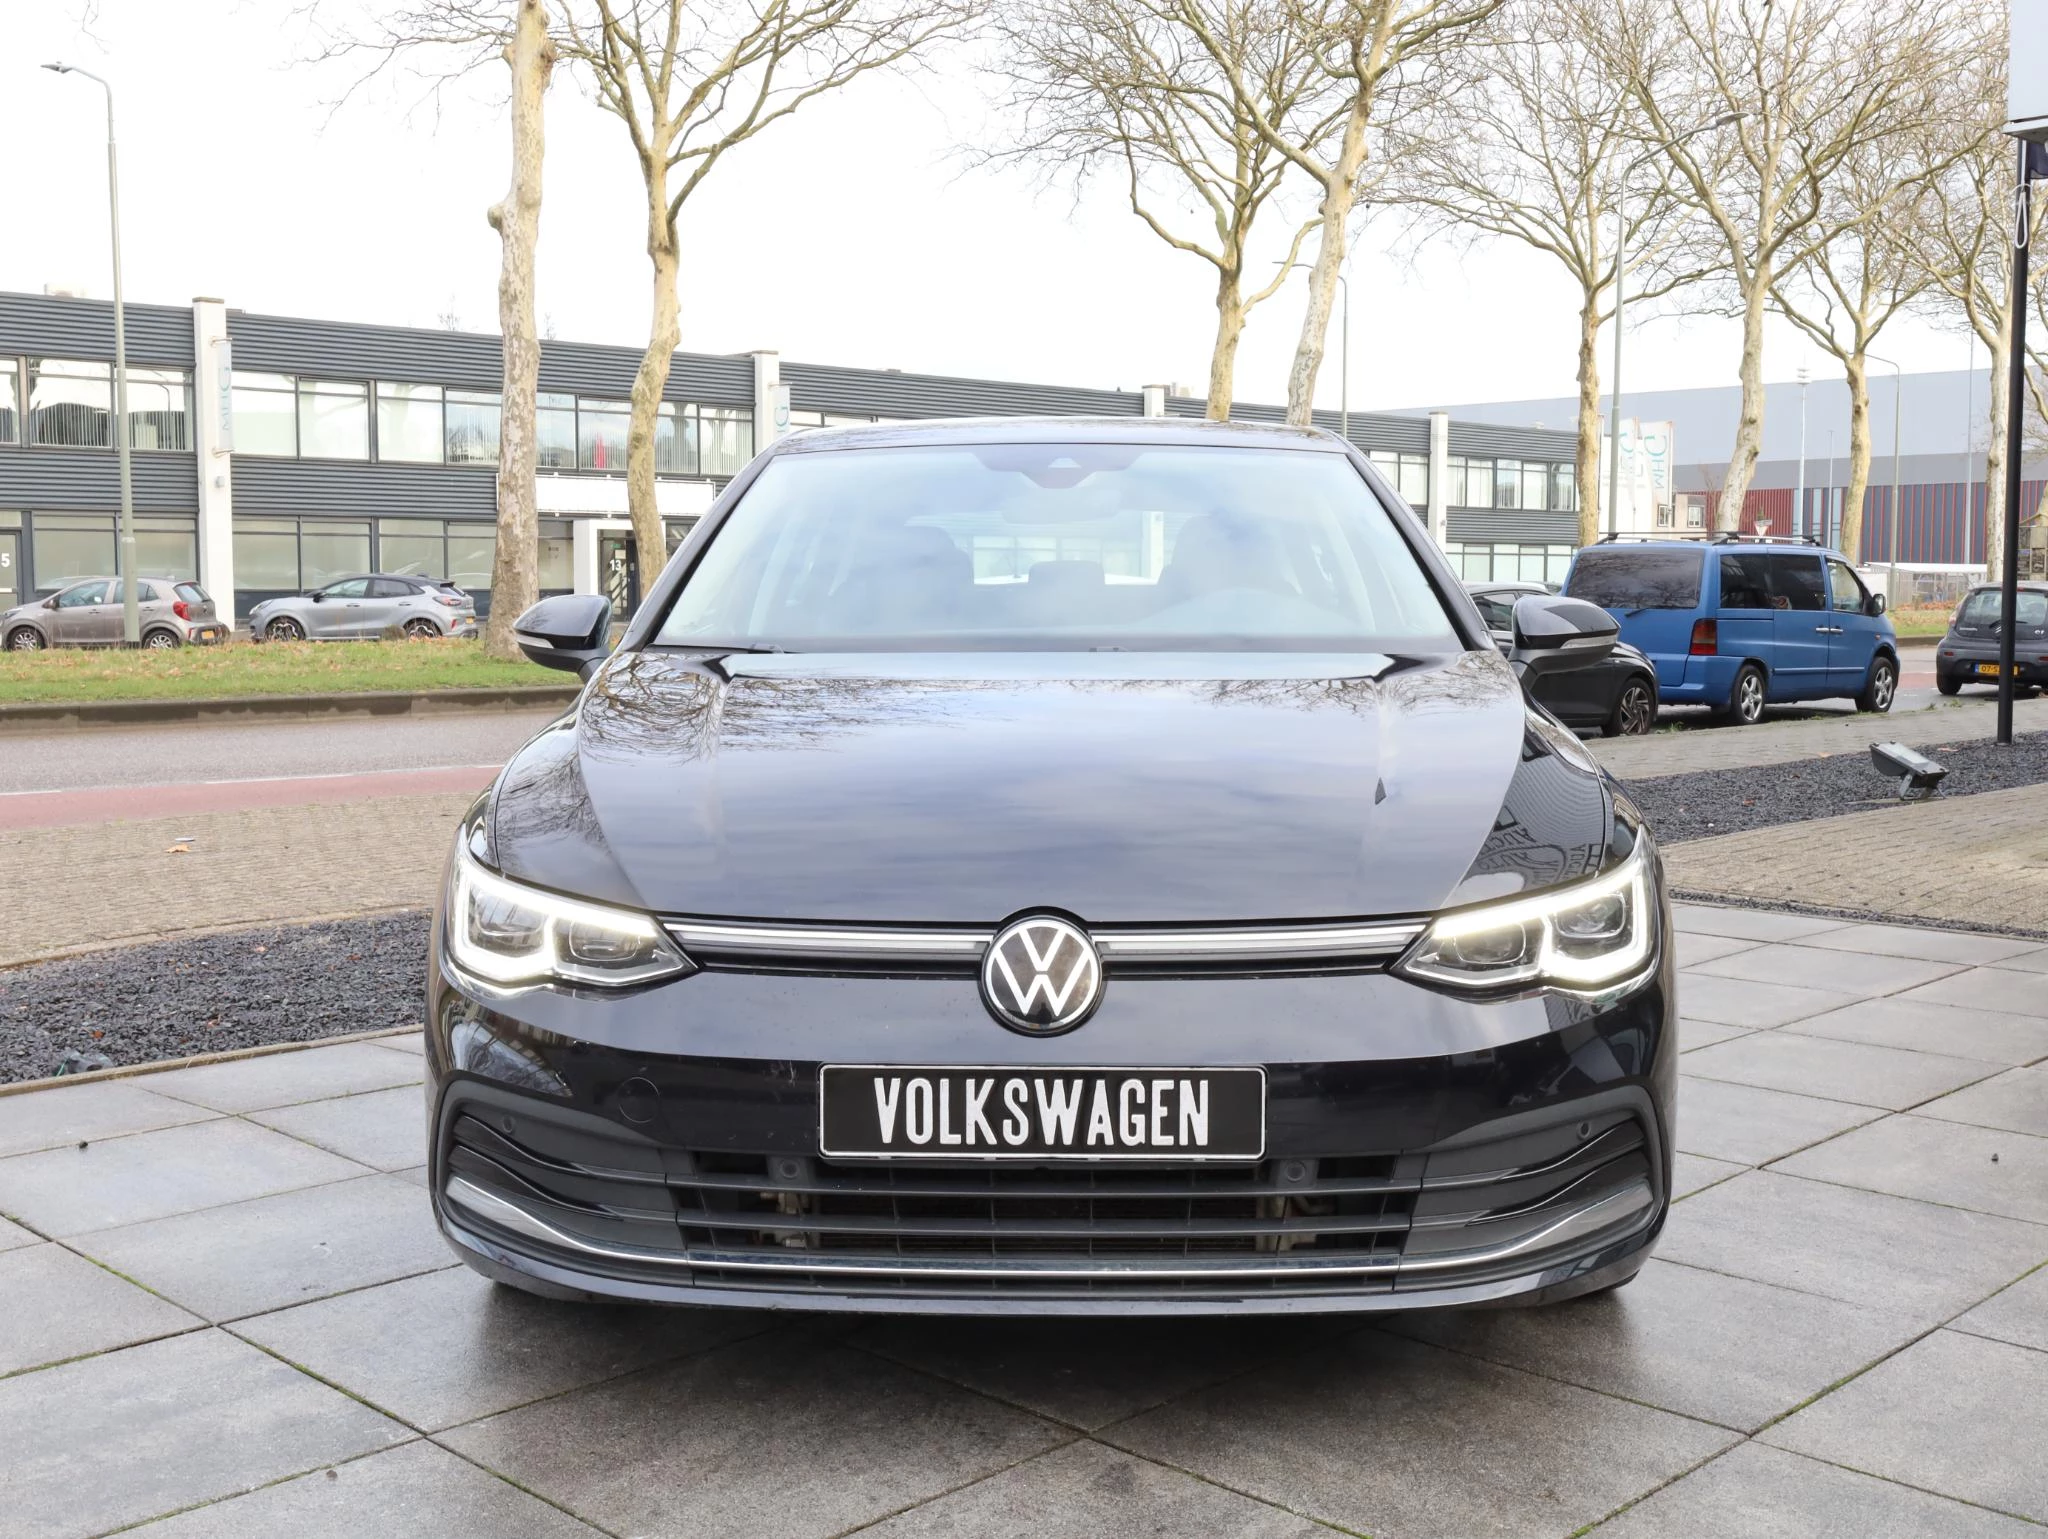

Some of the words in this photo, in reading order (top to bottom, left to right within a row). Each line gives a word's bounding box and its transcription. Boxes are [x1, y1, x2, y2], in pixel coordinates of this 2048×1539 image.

[1, 552, 10, 568] 5
[609, 559, 622, 571] 13
[873, 1076, 1210, 1147] VOLKSWAGEN
